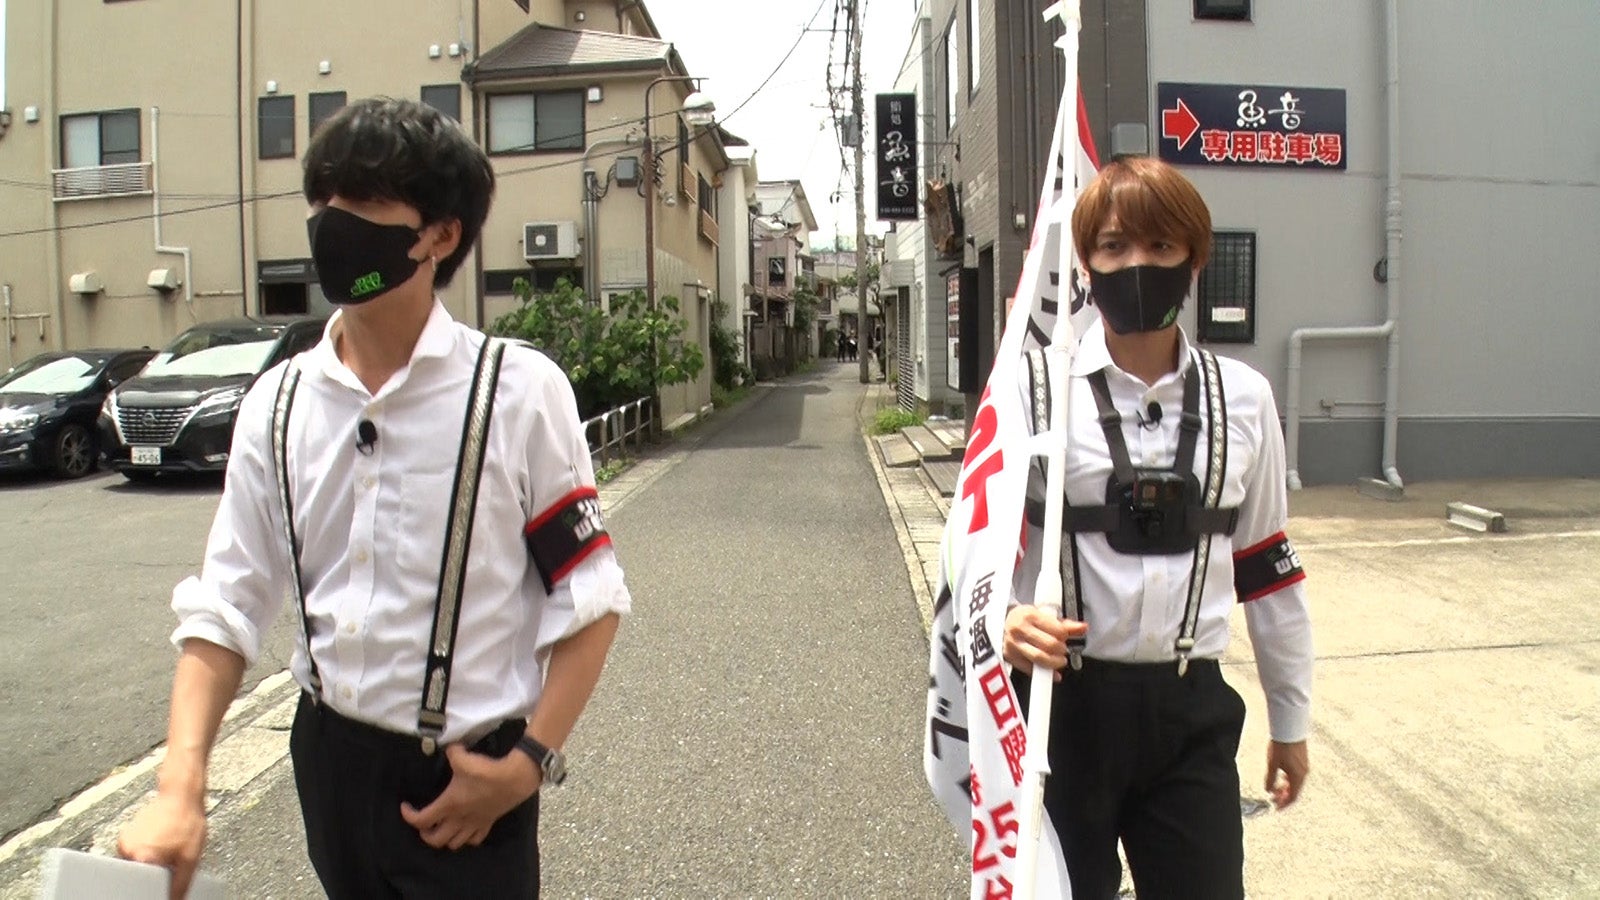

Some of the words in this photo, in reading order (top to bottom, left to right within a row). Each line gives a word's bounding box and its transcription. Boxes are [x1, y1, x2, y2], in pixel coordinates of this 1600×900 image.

[1201, 129, 1341, 165] 専用駐車場
